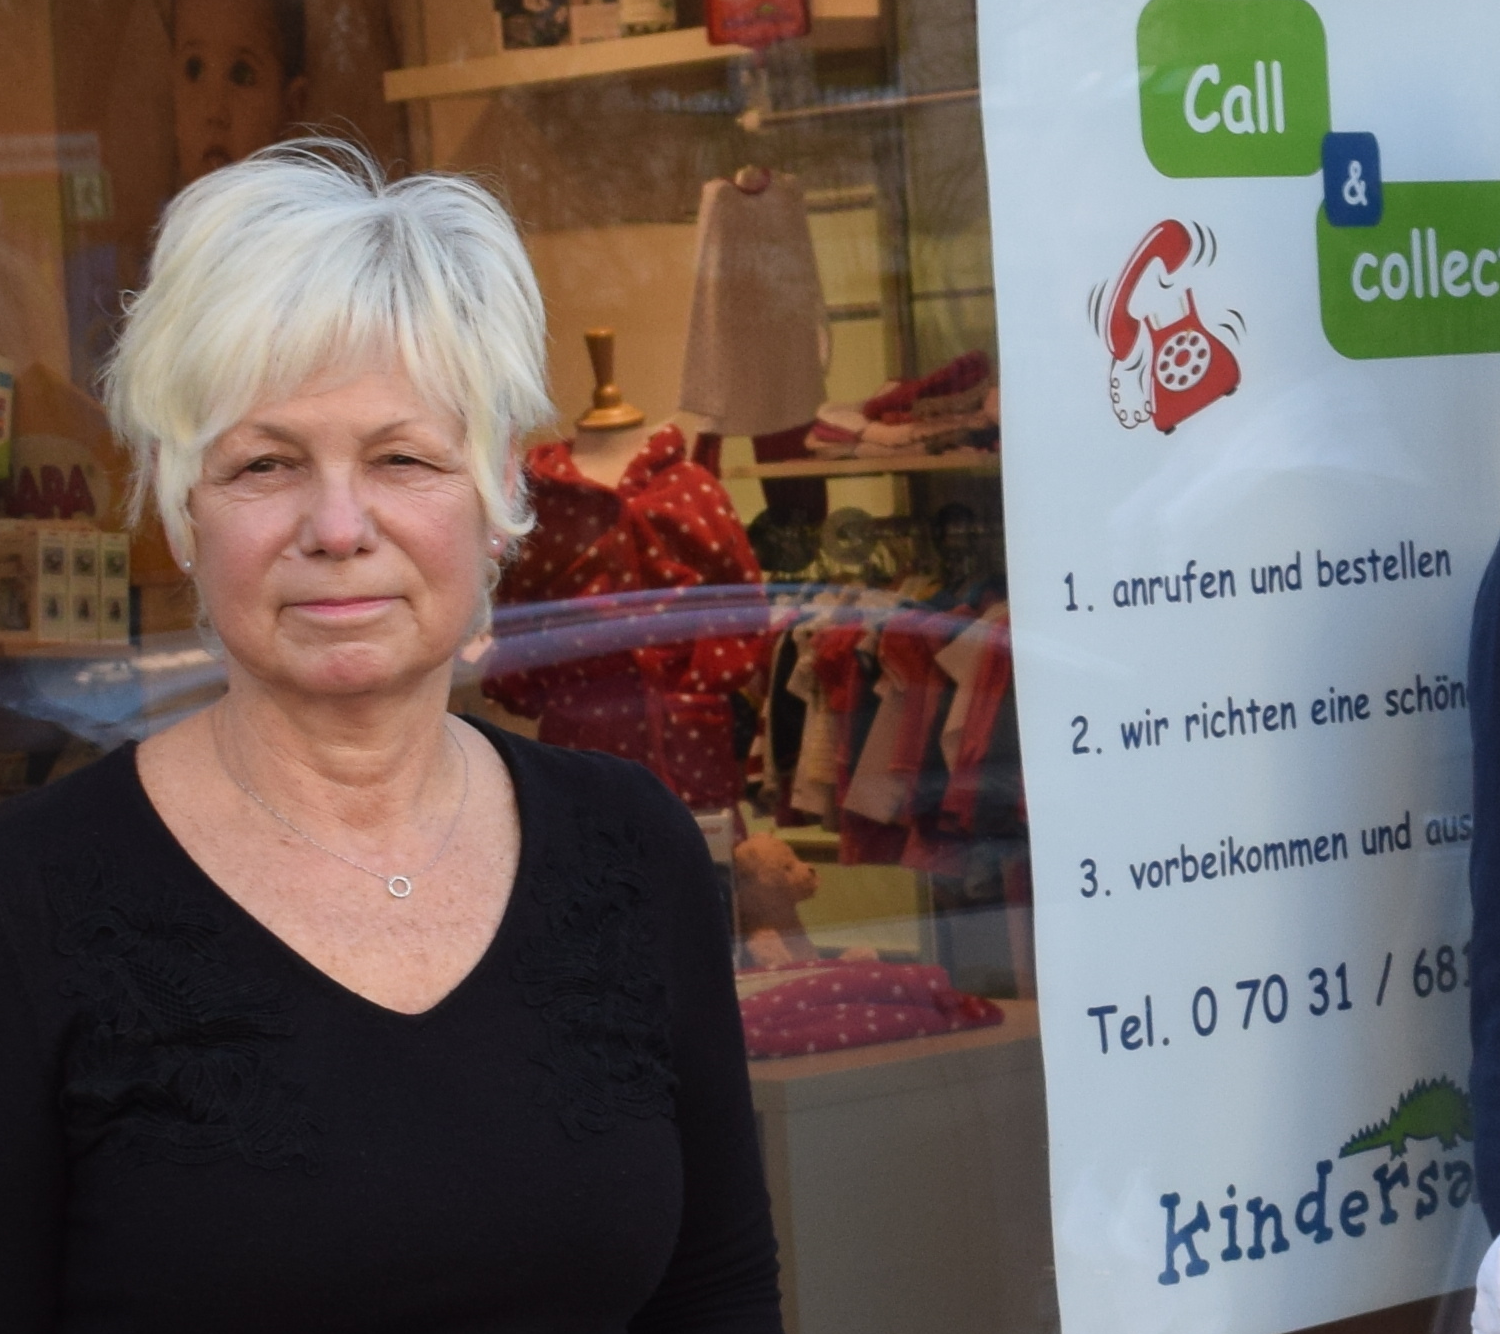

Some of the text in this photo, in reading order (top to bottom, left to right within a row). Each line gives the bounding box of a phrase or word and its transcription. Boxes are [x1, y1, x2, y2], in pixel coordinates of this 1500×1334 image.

[1182, 61, 1286, 135] Call
[1342, 159, 1369, 208] &
[1064, 540, 1453, 613] 1. anrufen und bestellen
[1071, 673, 1469, 756] 2. wir richten eine schön
[1079, 858, 1112, 898] 3.
[1128, 835, 1349, 890] vorbeikommen
[1360, 810, 1412, 856] und
[1087, 993, 1170, 1055] Tel.
[1191, 985, 1218, 1037] 0
[1235, 973, 1289, 1030] 70
[1307, 962, 1353, 1016] 31
